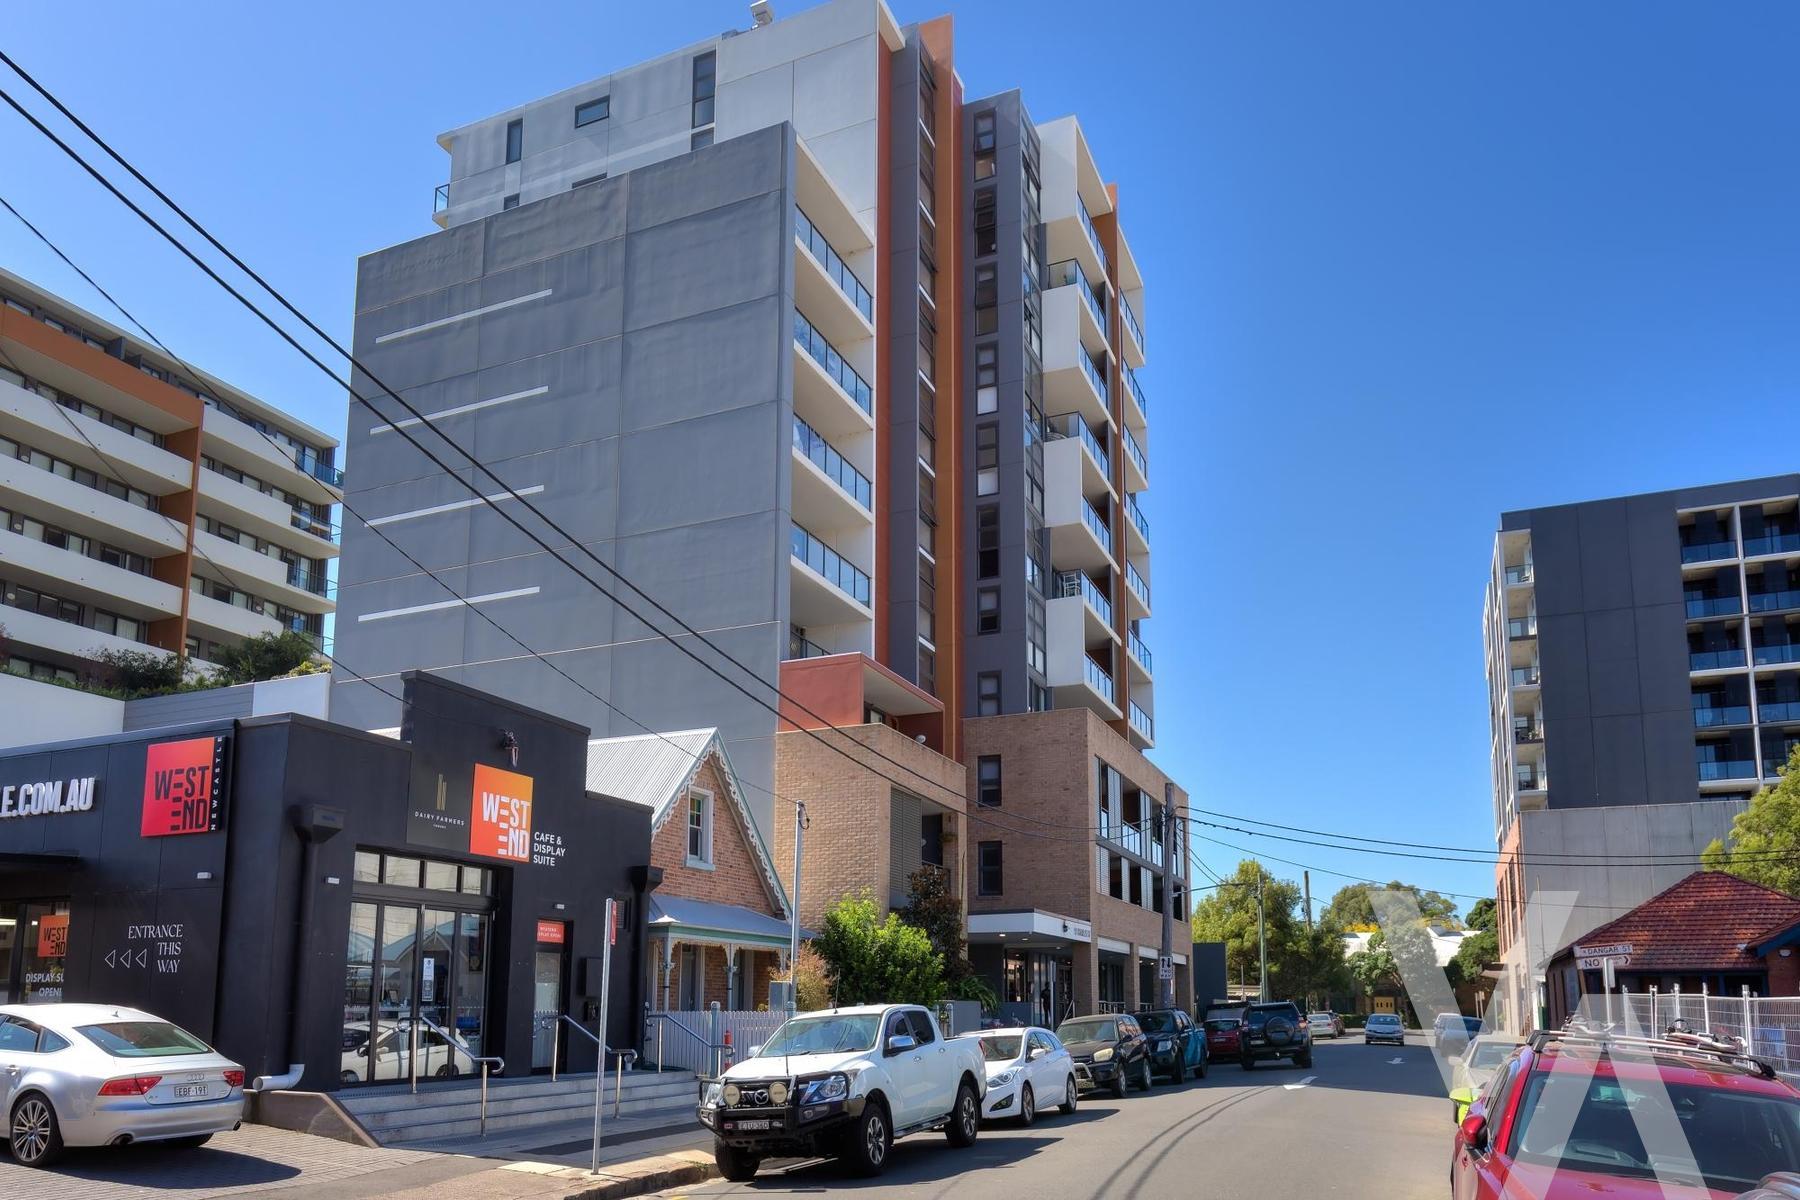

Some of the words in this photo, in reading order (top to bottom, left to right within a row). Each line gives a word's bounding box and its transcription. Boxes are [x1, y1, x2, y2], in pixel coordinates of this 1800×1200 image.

[154, 765, 210, 803] WEST
[211, 736, 223, 830] NEWCASTLE
[0, 777, 95, 818] E.COM.AU
[170, 796, 208, 832] END
[482, 791, 532, 830] WEST
[414, 811, 435, 820] DAIRY
[436, 815, 465, 826] FARMERS
[497, 822, 530, 859] END
[534, 831, 555, 844] CAFE
[556, 836, 562, 845] &
[533, 843, 566, 857] DISPLAY
[533, 854, 556, 867] SUITE
[43, 926, 67, 943] WEST
[128, 924, 184, 939] ENTRANCE
[157, 941, 182, 956] THIS
[157, 959, 180, 973] WAY
[1584, 958, 1600, 967] NO
[25, 973, 56, 983] DISPLAY
